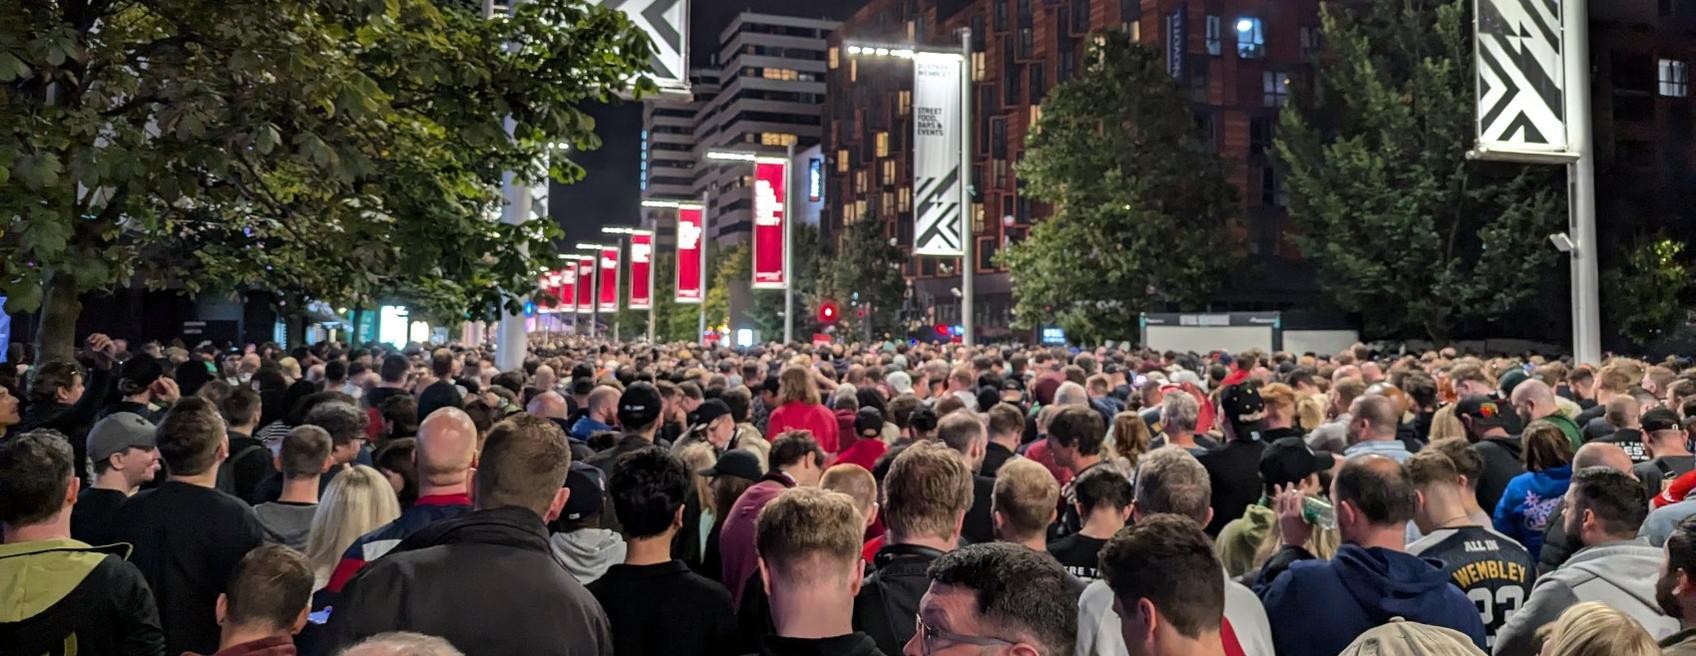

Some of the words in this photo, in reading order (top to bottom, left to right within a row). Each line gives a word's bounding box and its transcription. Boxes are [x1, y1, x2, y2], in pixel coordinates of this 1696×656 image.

[1172, 9, 1181, 78] NOVOTEL
[918, 107, 942, 115] STREET
[918, 121, 936, 129] BARS
[1464, 540, 1486, 552] ALL
[1486, 540, 1499, 551] IN
[1452, 560, 1525, 588] WEMBLEY
